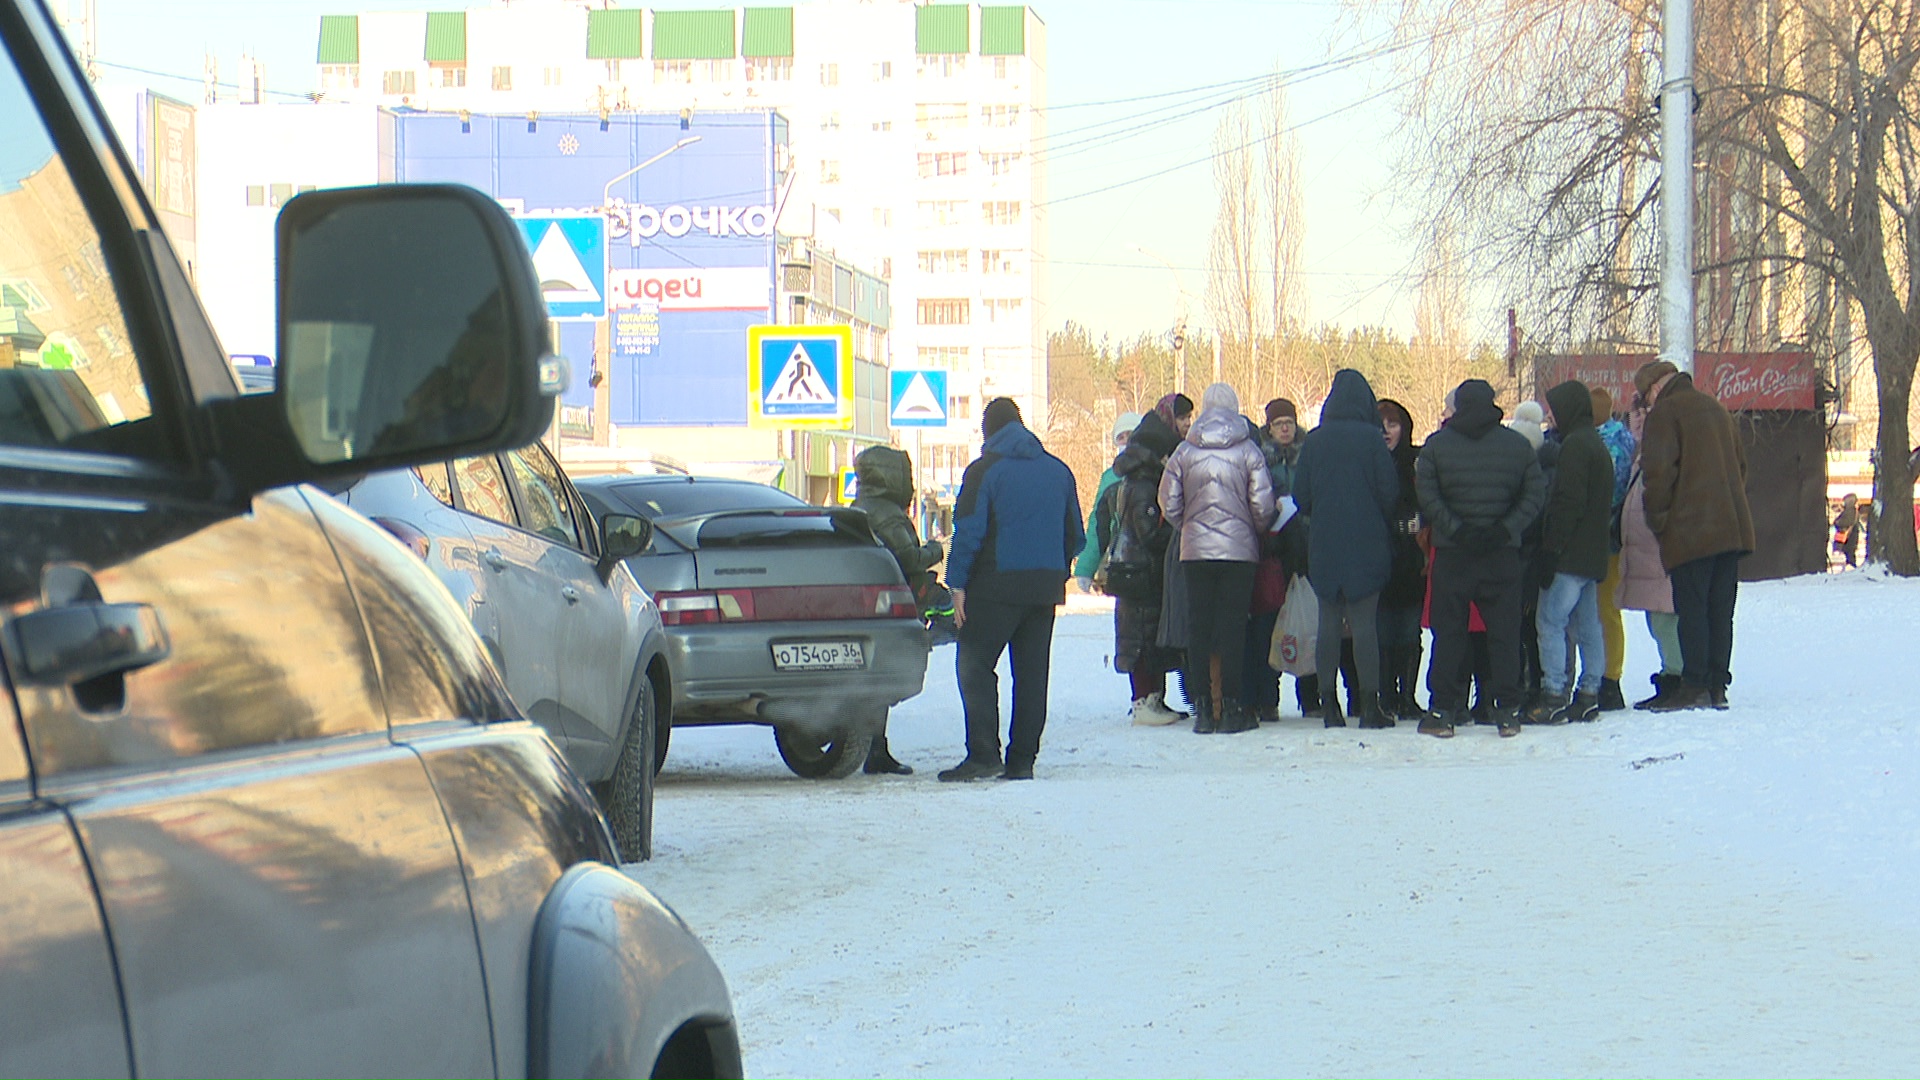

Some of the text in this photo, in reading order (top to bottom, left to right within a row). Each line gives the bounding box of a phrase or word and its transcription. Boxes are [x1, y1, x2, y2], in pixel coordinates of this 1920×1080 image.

[624, 276, 702, 302] идей
[1714, 362, 1759, 401] Робин
[780, 643, 857, 664] О754ОР 36
